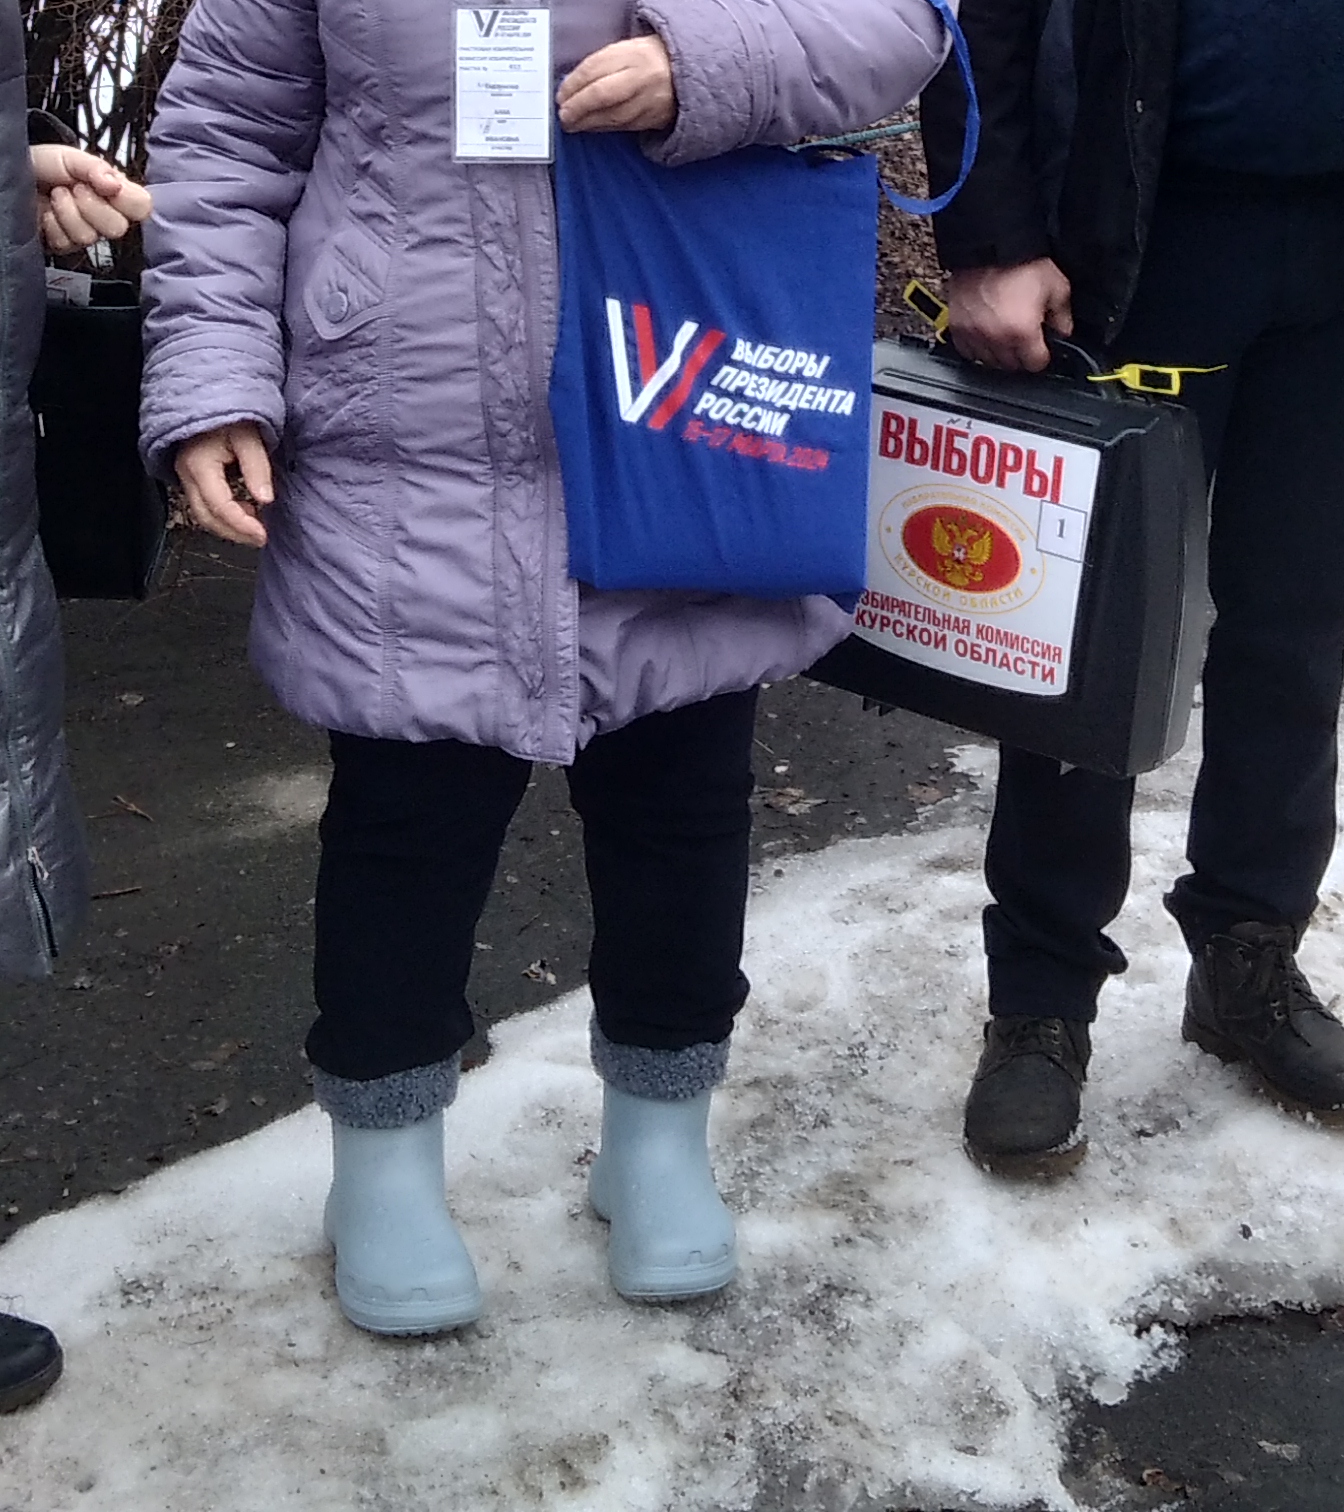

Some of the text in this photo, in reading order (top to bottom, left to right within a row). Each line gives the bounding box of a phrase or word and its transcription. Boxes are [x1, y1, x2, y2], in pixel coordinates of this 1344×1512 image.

[731, 338, 831, 378] ВЫБОРЫ
[693, 392, 791, 437] РОССИИ
[710, 365, 856, 416] ПРЕЗИДЕНТА
[878, 410, 1064, 503] ВЫБОРЫ
[1056, 518, 1066, 540] 1
[894, 553, 1024, 609] КУРСКОЙ ОБЛАСТИ
[855, 607, 1056, 685] КУРСКОЙ ОБЛАСТИ
[858, 590, 1063, 664] ЗБИРАТЕЛЬНАЯ КОМИССИЯ
